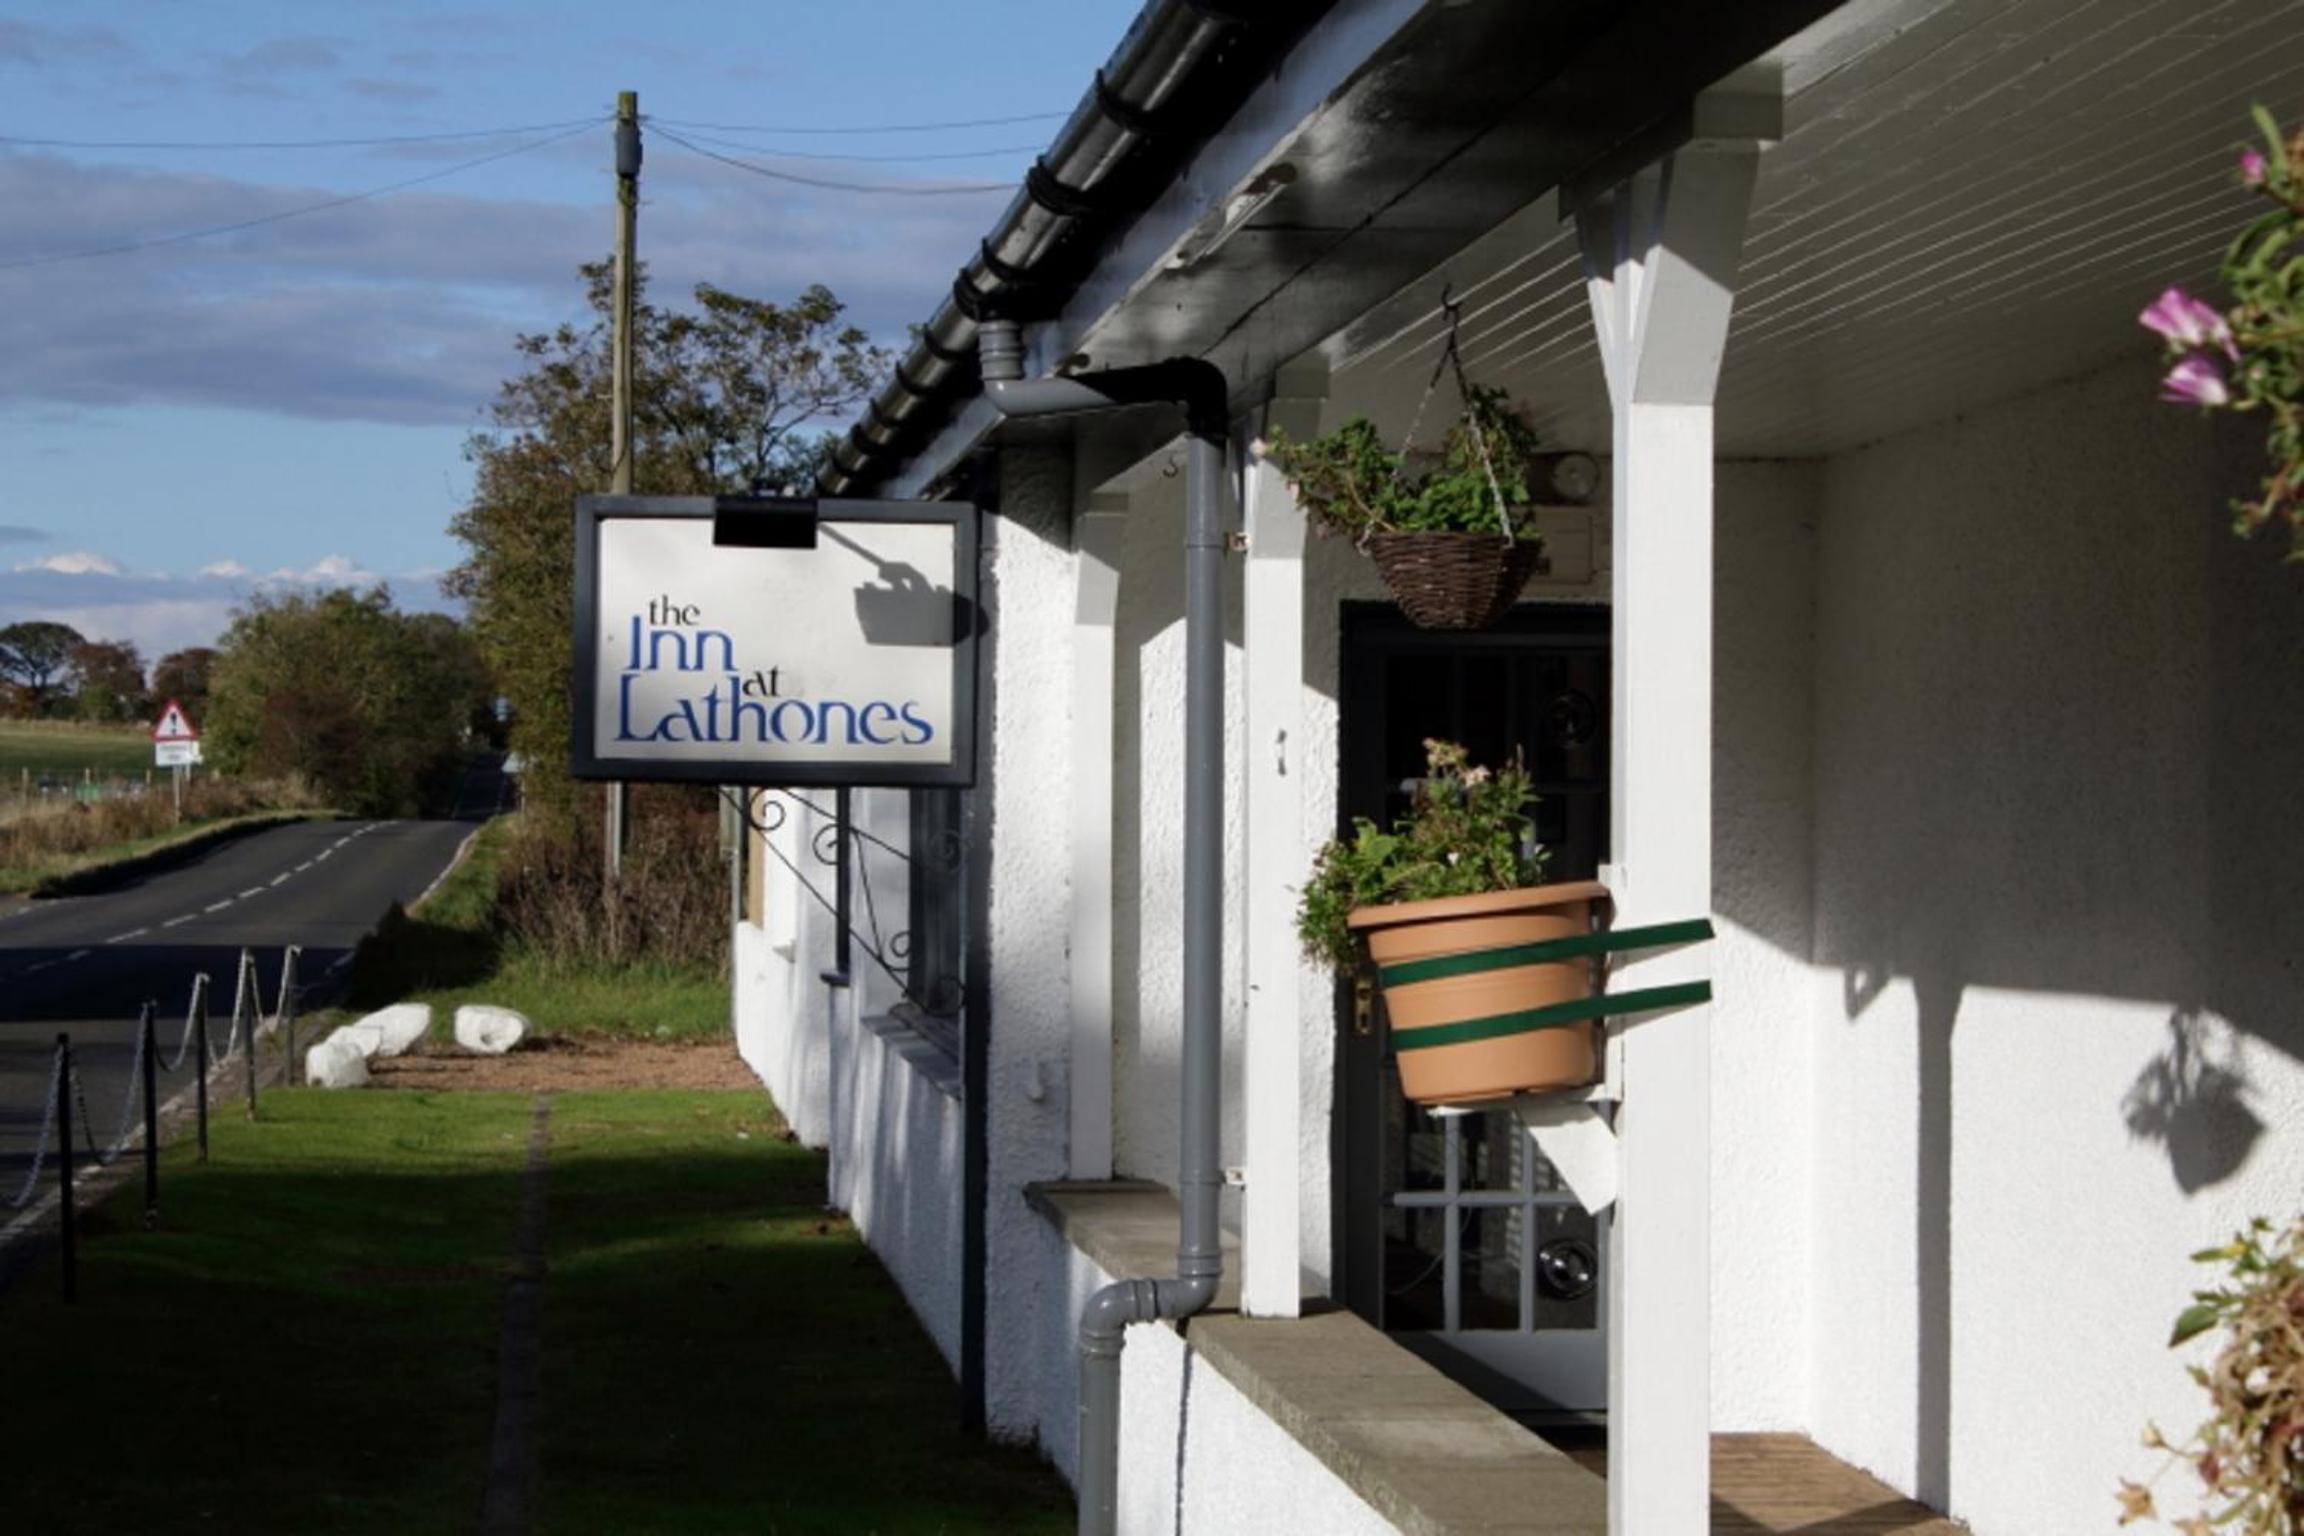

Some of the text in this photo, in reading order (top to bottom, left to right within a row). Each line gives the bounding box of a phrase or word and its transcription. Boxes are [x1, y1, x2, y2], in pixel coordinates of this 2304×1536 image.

[649, 595, 701, 626] the
[626, 615, 738, 671] Inn
[742, 666, 784, 697] at
[613, 673, 935, 745] Lathones
